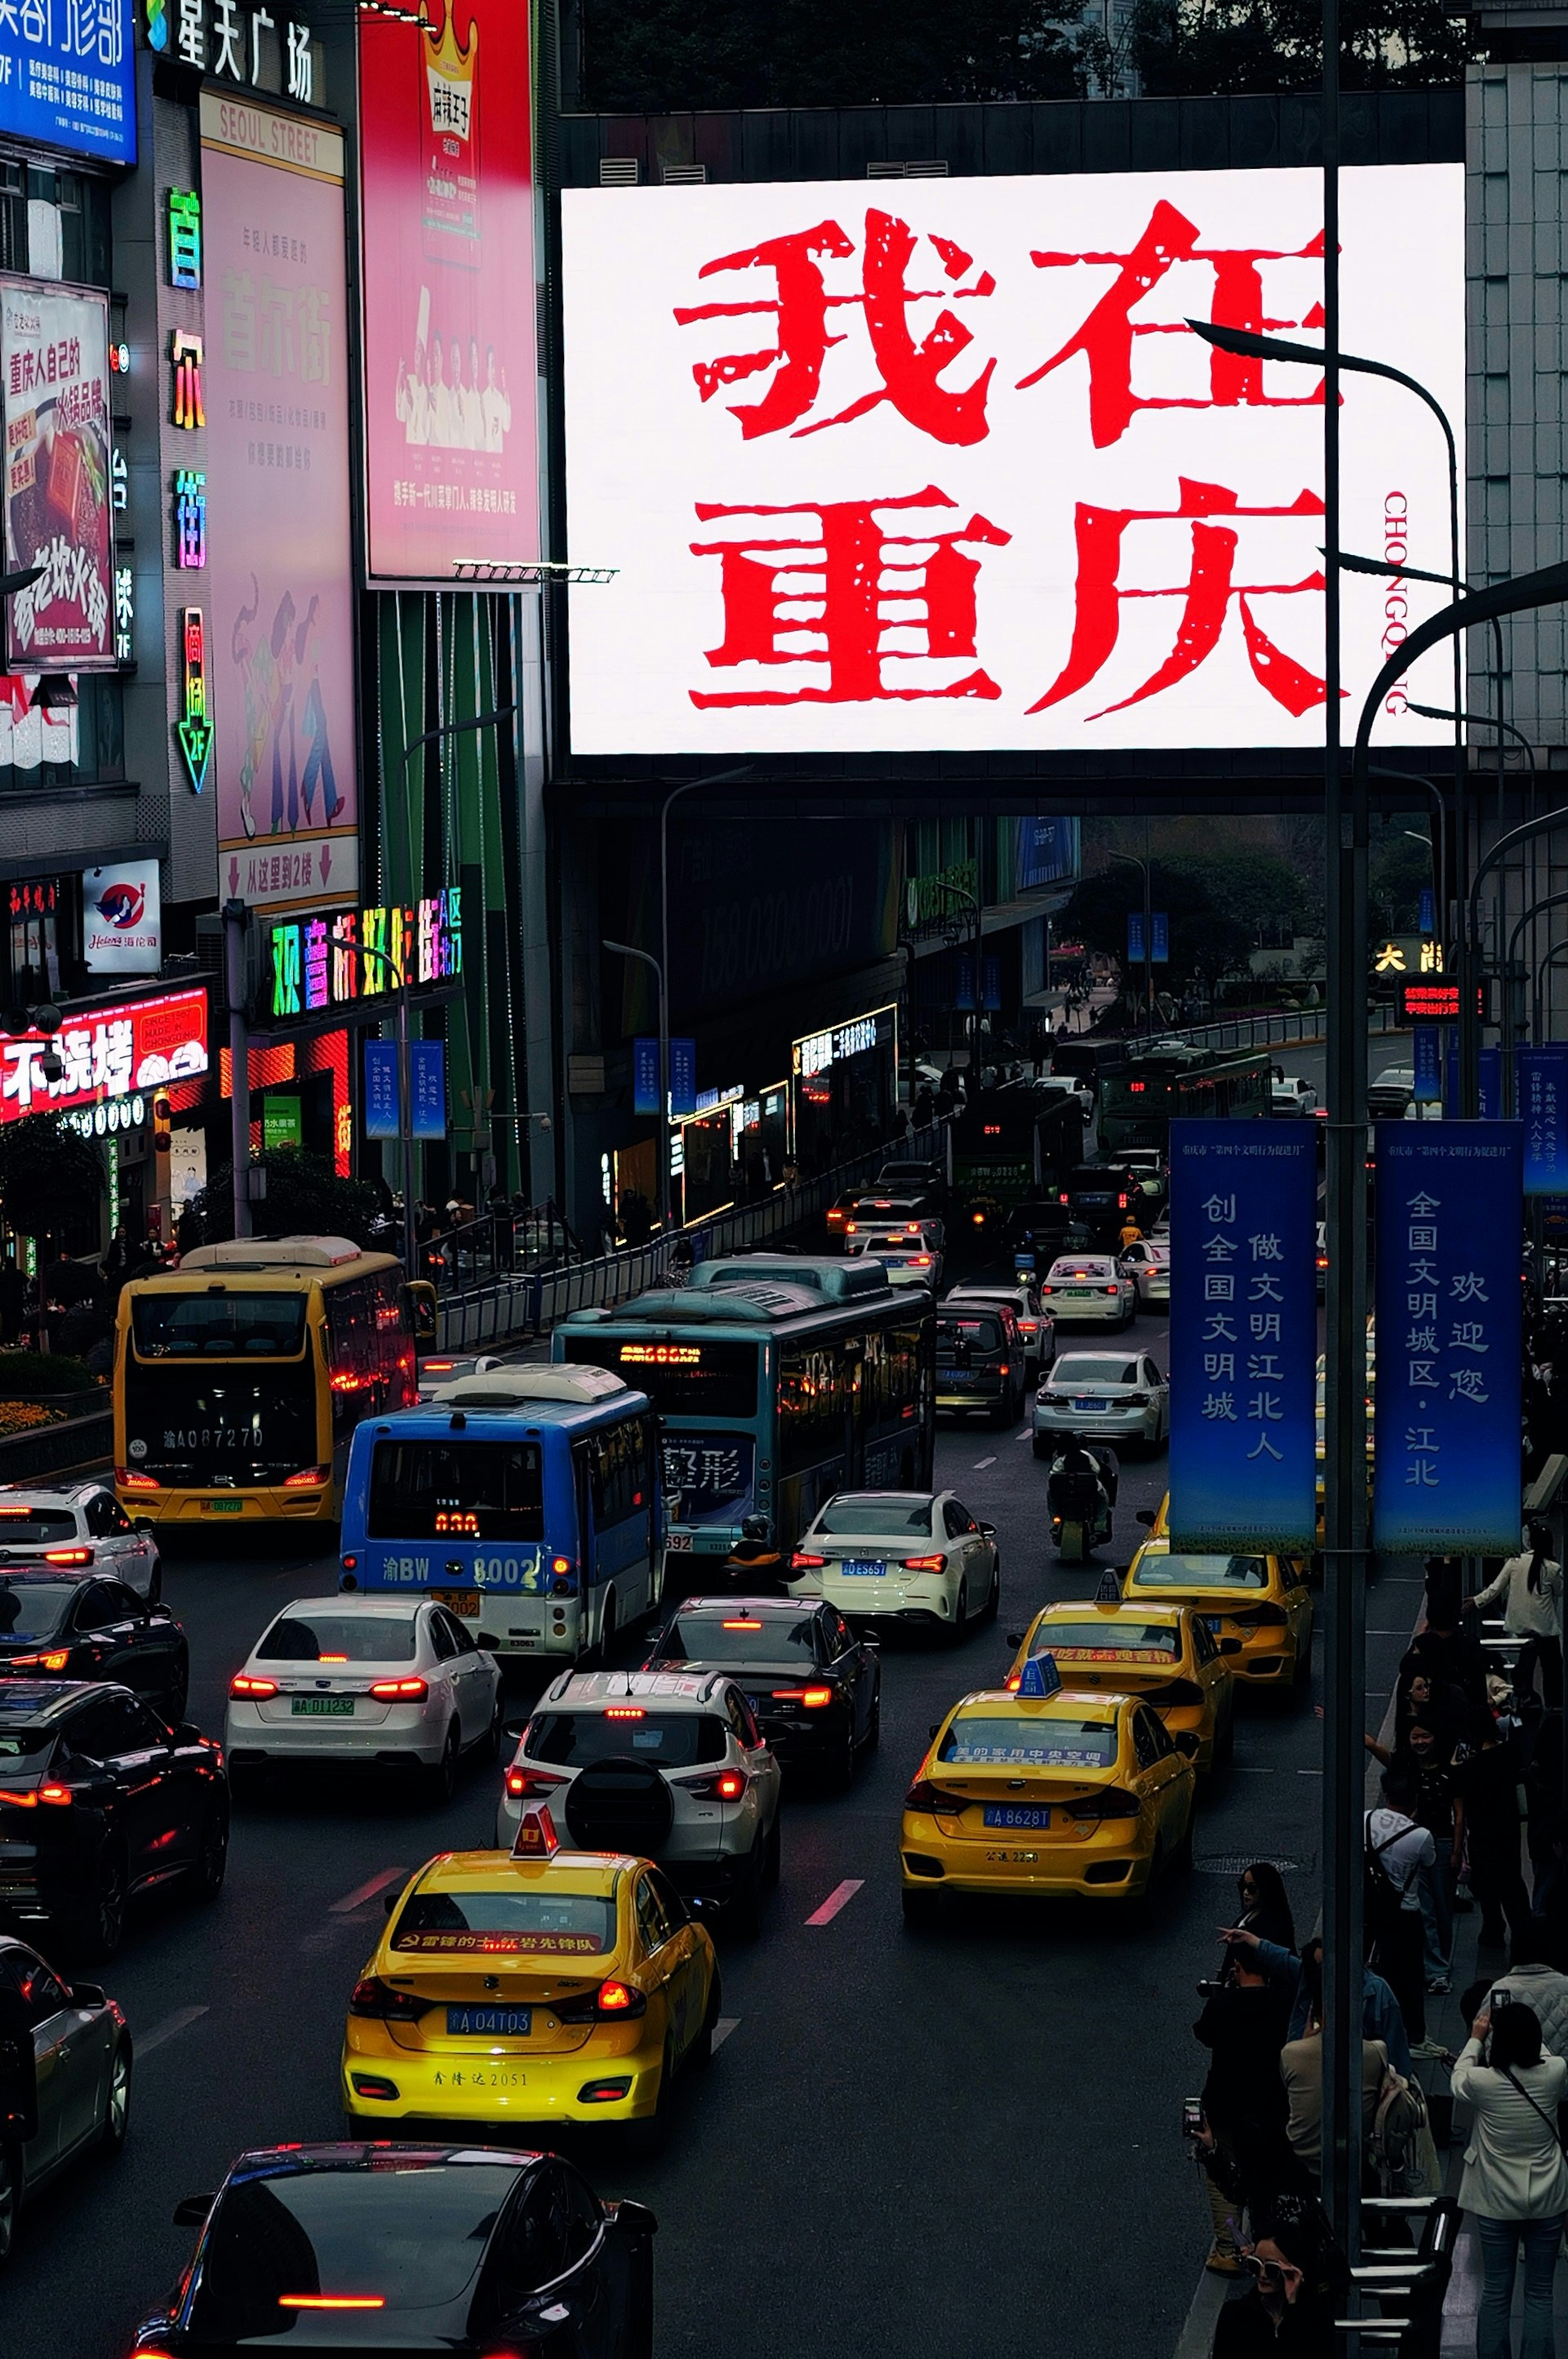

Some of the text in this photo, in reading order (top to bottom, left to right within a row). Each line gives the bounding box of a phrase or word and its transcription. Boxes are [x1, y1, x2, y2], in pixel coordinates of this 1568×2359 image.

[178, 0, 312, 103] 星天广场
[220, 104, 319, 164] SEOUL STREET
[433, 82, 469, 134] 麻辣王子
[220, 265, 331, 387] 首尔街
[672, 198, 1343, 447] 我在
[10, 335, 81, 397] 重庆人自己的
[56, 377, 103, 432] 火锅品牌
[688, 476, 1352, 723] 重庆
[188, 624, 204, 717] 商场
[190, 730, 204, 762] 2F
[247, 851, 313, 892] 从这里到2楼
[88, 935, 157, 950] Helen's 海伦司
[1530, 1071, 1543, 1162] 雷锋精神 人人可学
[1544, 1082, 1557, 1125] 奉献爱心
[1201, 1193, 1239, 1421] 创全国文明城
[1405, 1190, 1442, 1486] 全国文明城区·江北
[1448, 1271, 1490, 1404] 欢迎您
[1247, 1233, 1285, 1461] 做文明江北人
[662, 1446, 740, 1490] 整形
[383, 1557, 430, 1582] 渝BW
[955, 1747, 1101, 1761] 美的家用中央空调
